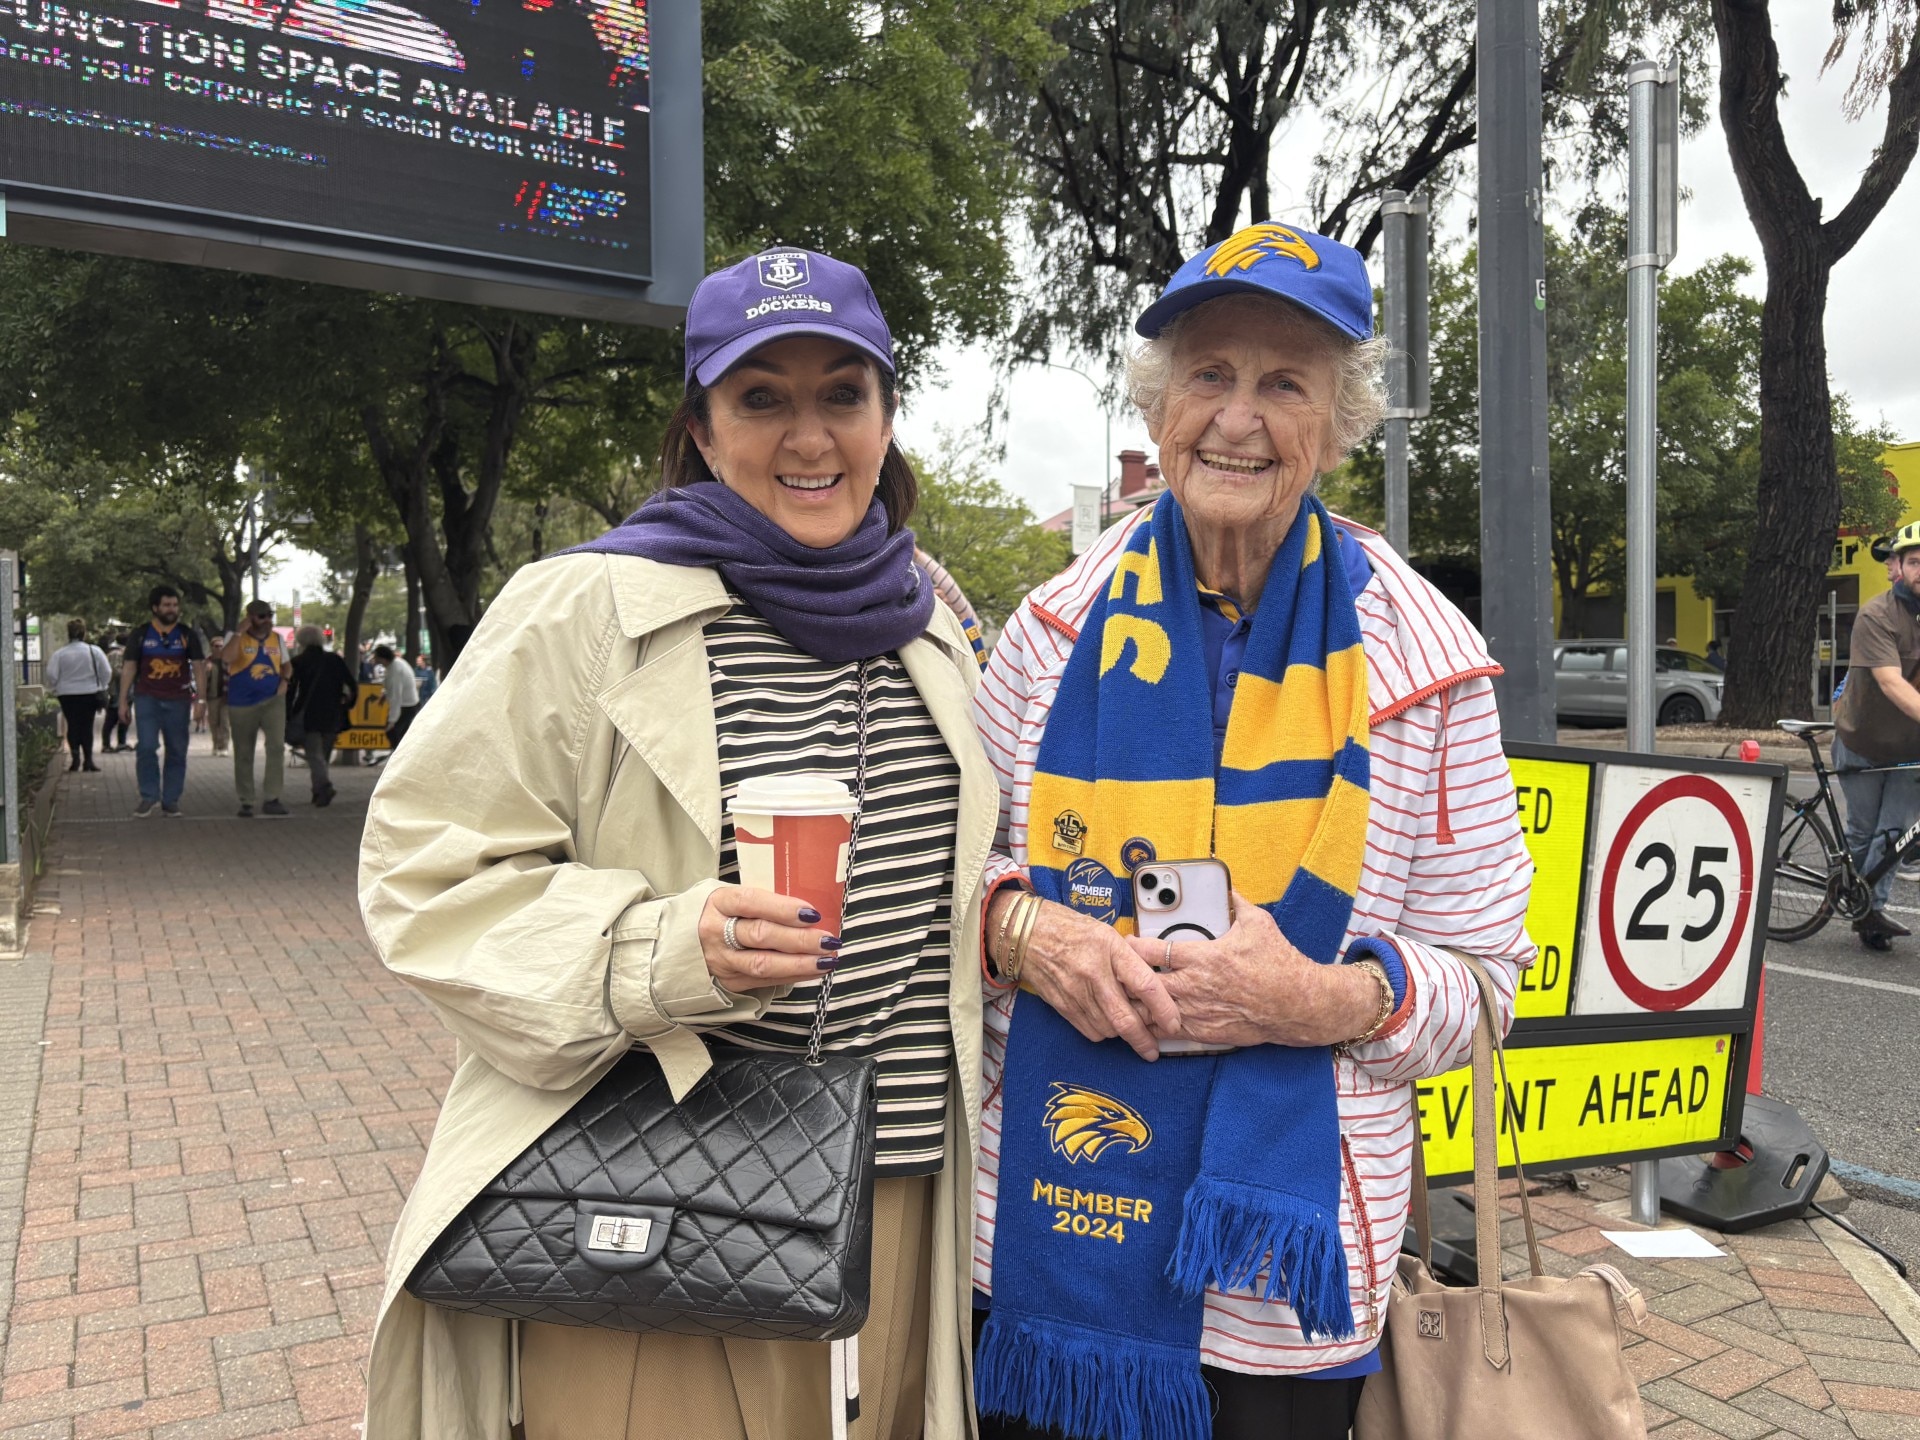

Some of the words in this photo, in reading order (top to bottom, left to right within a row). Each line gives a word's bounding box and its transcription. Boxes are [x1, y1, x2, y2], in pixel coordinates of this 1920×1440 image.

[0, 0, 247, 73] UNCTION
[257, 44, 401, 102] SPACE
[412, 78, 626, 149] AVAILABLE
[362, 107, 442, 140] social
[746, 299, 833, 320] DOCKERS
[349, 732, 386, 746] RIGHT
[1071, 882, 1113, 898] MEMBER
[1084, 895, 1112, 908] 2024
[1625, 842, 1729, 943] 25
[1418, 1078, 1557, 1143] EVNT
[1578, 1065, 1710, 1128] AHEAD
[1032, 1178, 1153, 1223] MEMBER
[1052, 1210, 1125, 1244] 2024
